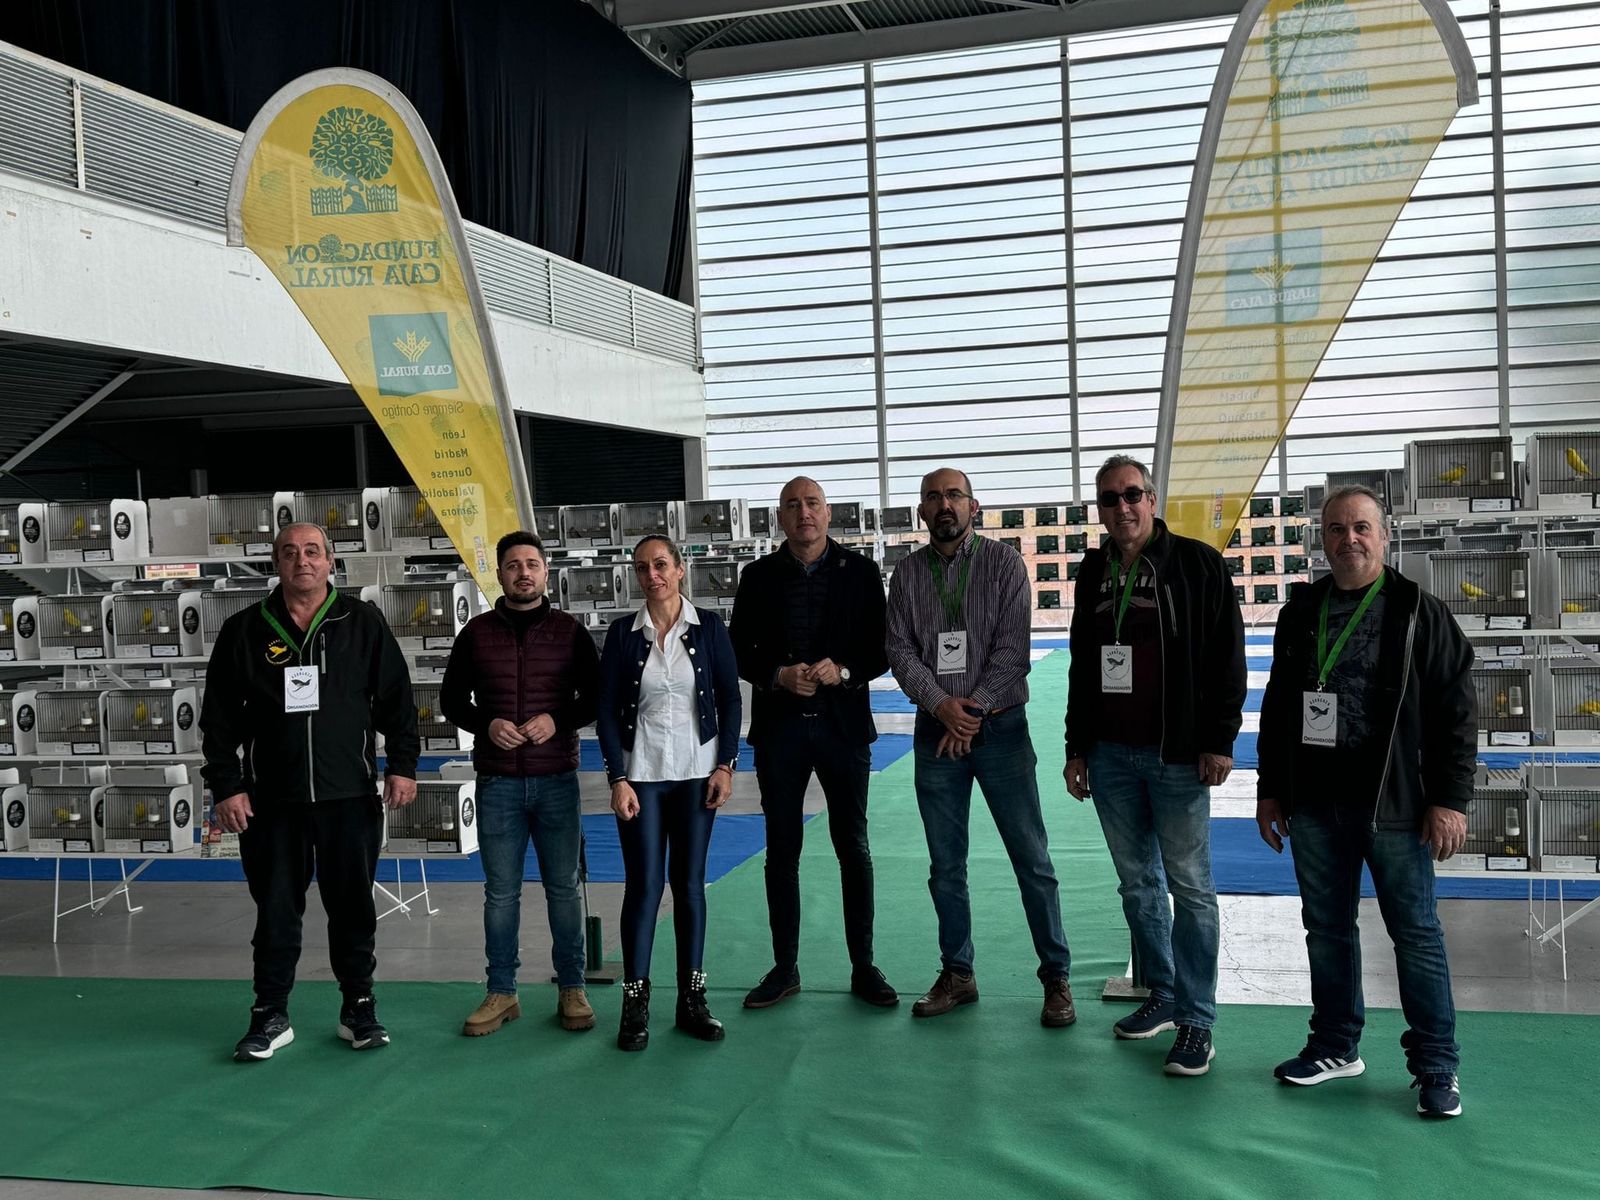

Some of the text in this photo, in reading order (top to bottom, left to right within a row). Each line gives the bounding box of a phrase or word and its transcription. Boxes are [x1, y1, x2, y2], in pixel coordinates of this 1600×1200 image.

[1226, 151, 1412, 209] CAJA RURAL
[1230, 286, 1315, 309] CAJA RURAL
